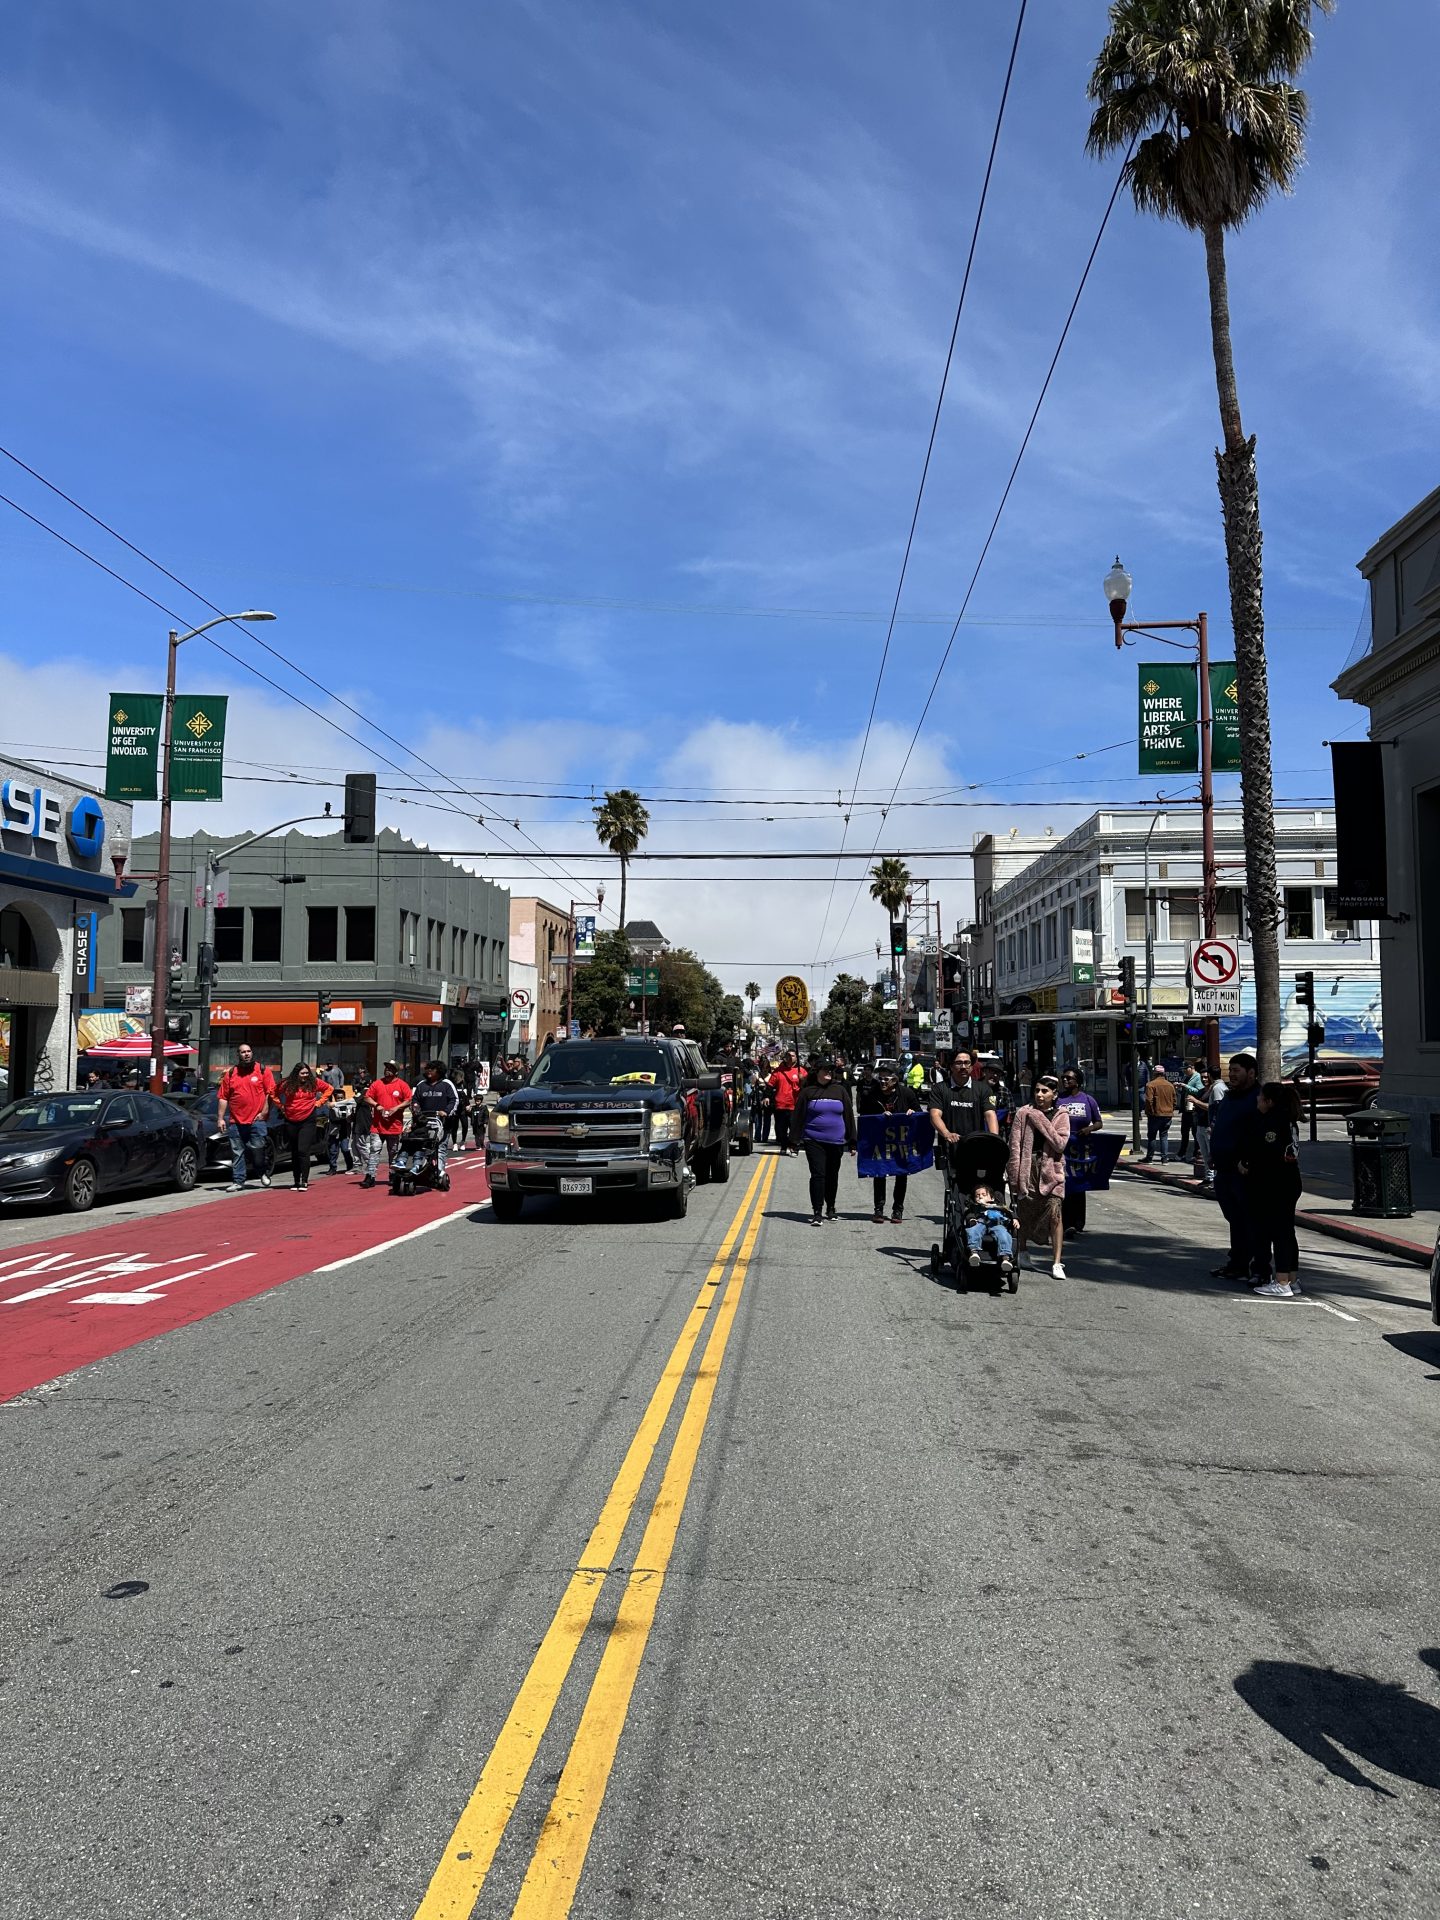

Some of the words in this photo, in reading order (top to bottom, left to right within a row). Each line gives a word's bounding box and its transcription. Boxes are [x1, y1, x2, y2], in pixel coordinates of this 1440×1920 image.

[1143, 697, 1182, 709] WHERE
[1143, 710, 1186, 722] LIBERAL
[112, 726, 156, 736] UNIVERSITY
[1143, 724, 1171, 736] ARTS
[112, 736, 123, 746] OF
[122, 736, 137, 746] GET
[1143, 737, 1185, 750] THRIVE.
[111, 746, 148, 756] INVOLVED.
[0, 779, 63, 842] SE
[76, 930, 88, 976] CHASE
[925, 946, 938, 954] 20
[1194, 991, 1218, 1000] EXCEPT
[1220, 992, 1238, 1000] MUNI
[1197, 1003, 1211, 1012] AND
[1214, 1003, 1234, 1012] TAXIS
[885, 1125, 910, 1142] SF
[562, 1183, 590, 1192] 8X69393
